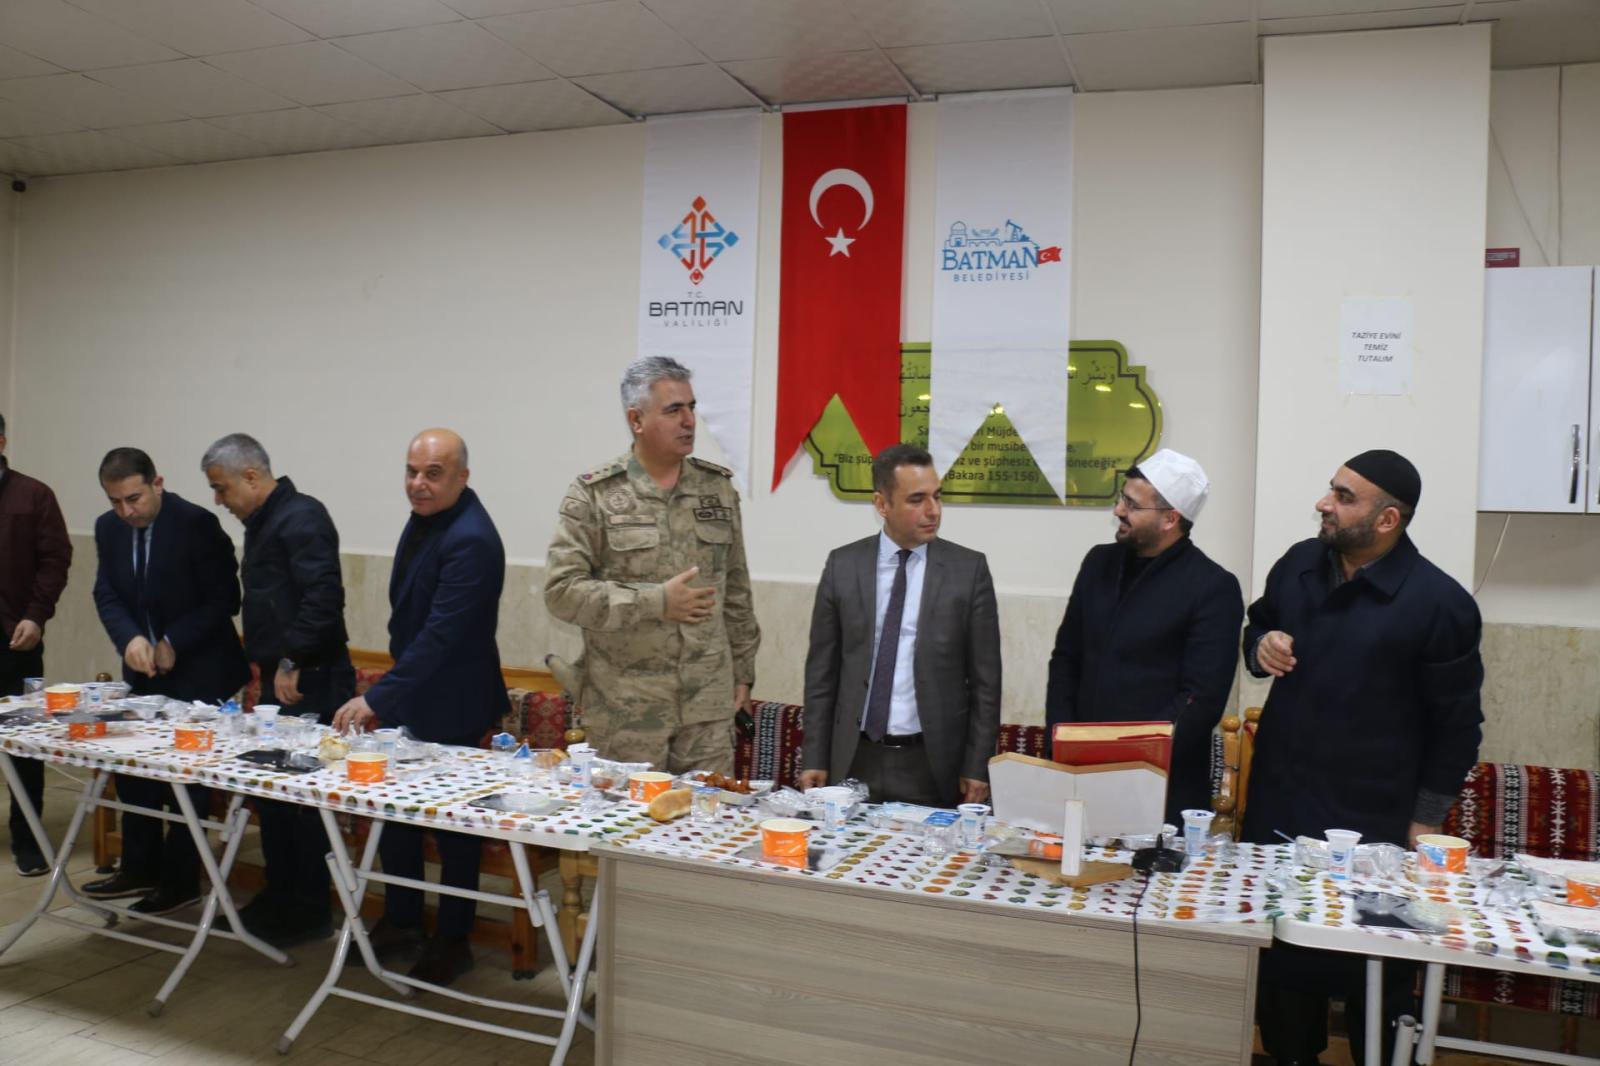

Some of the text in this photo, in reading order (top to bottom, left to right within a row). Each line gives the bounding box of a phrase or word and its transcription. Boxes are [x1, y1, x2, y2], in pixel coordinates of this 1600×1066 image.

[942, 246, 1039, 270] BATMAN
[953, 271, 1029, 282] BELEDİYESİ
[649, 300, 743, 317] BATMAN
[987, 425, 1019, 437] Müjde
[970, 441, 1027, 452] bir musibe
[968, 457, 980, 466] ve
